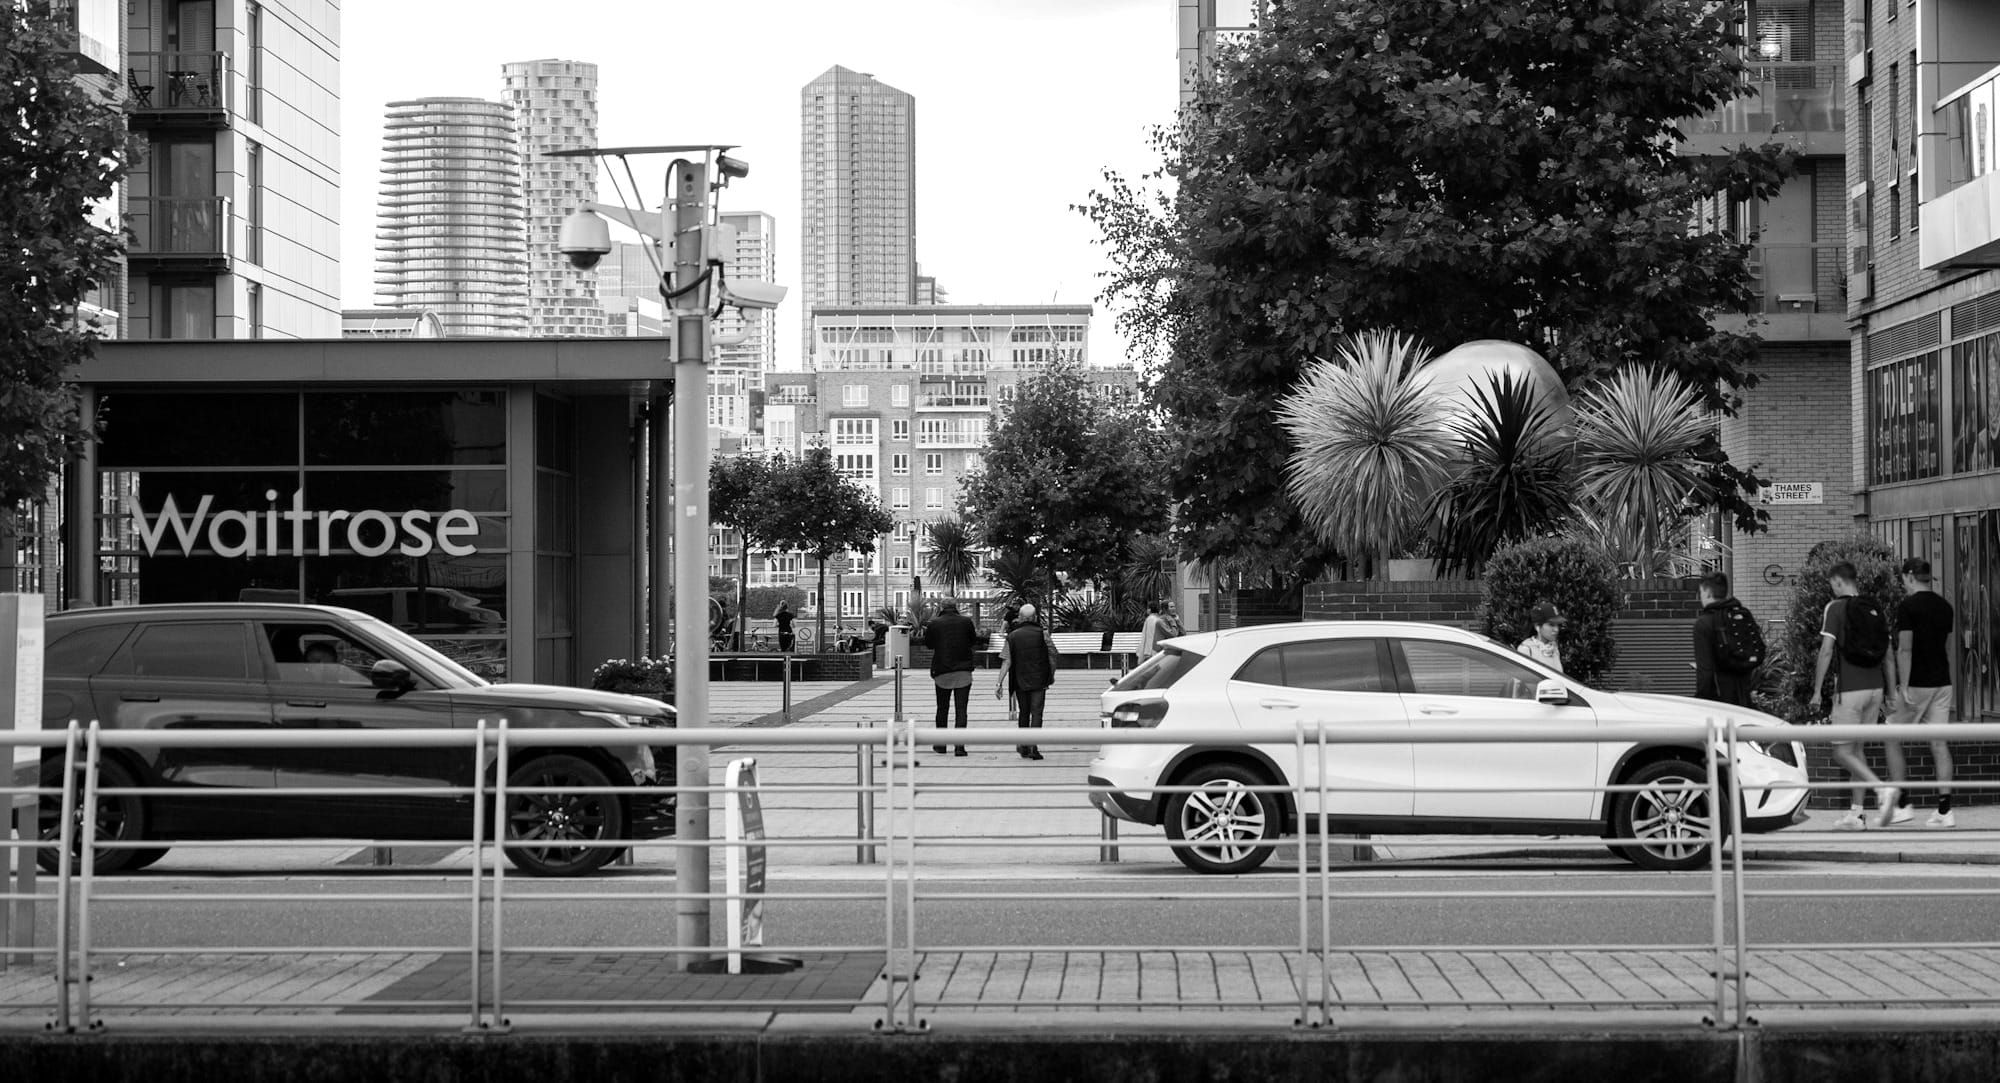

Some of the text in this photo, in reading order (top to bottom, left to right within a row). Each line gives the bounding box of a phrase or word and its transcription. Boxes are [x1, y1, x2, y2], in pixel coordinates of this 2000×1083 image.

[1774, 484, 1812, 492] THAMES
[1774, 492, 1810, 500] STREET
[128, 487, 480, 559] Waitrose
